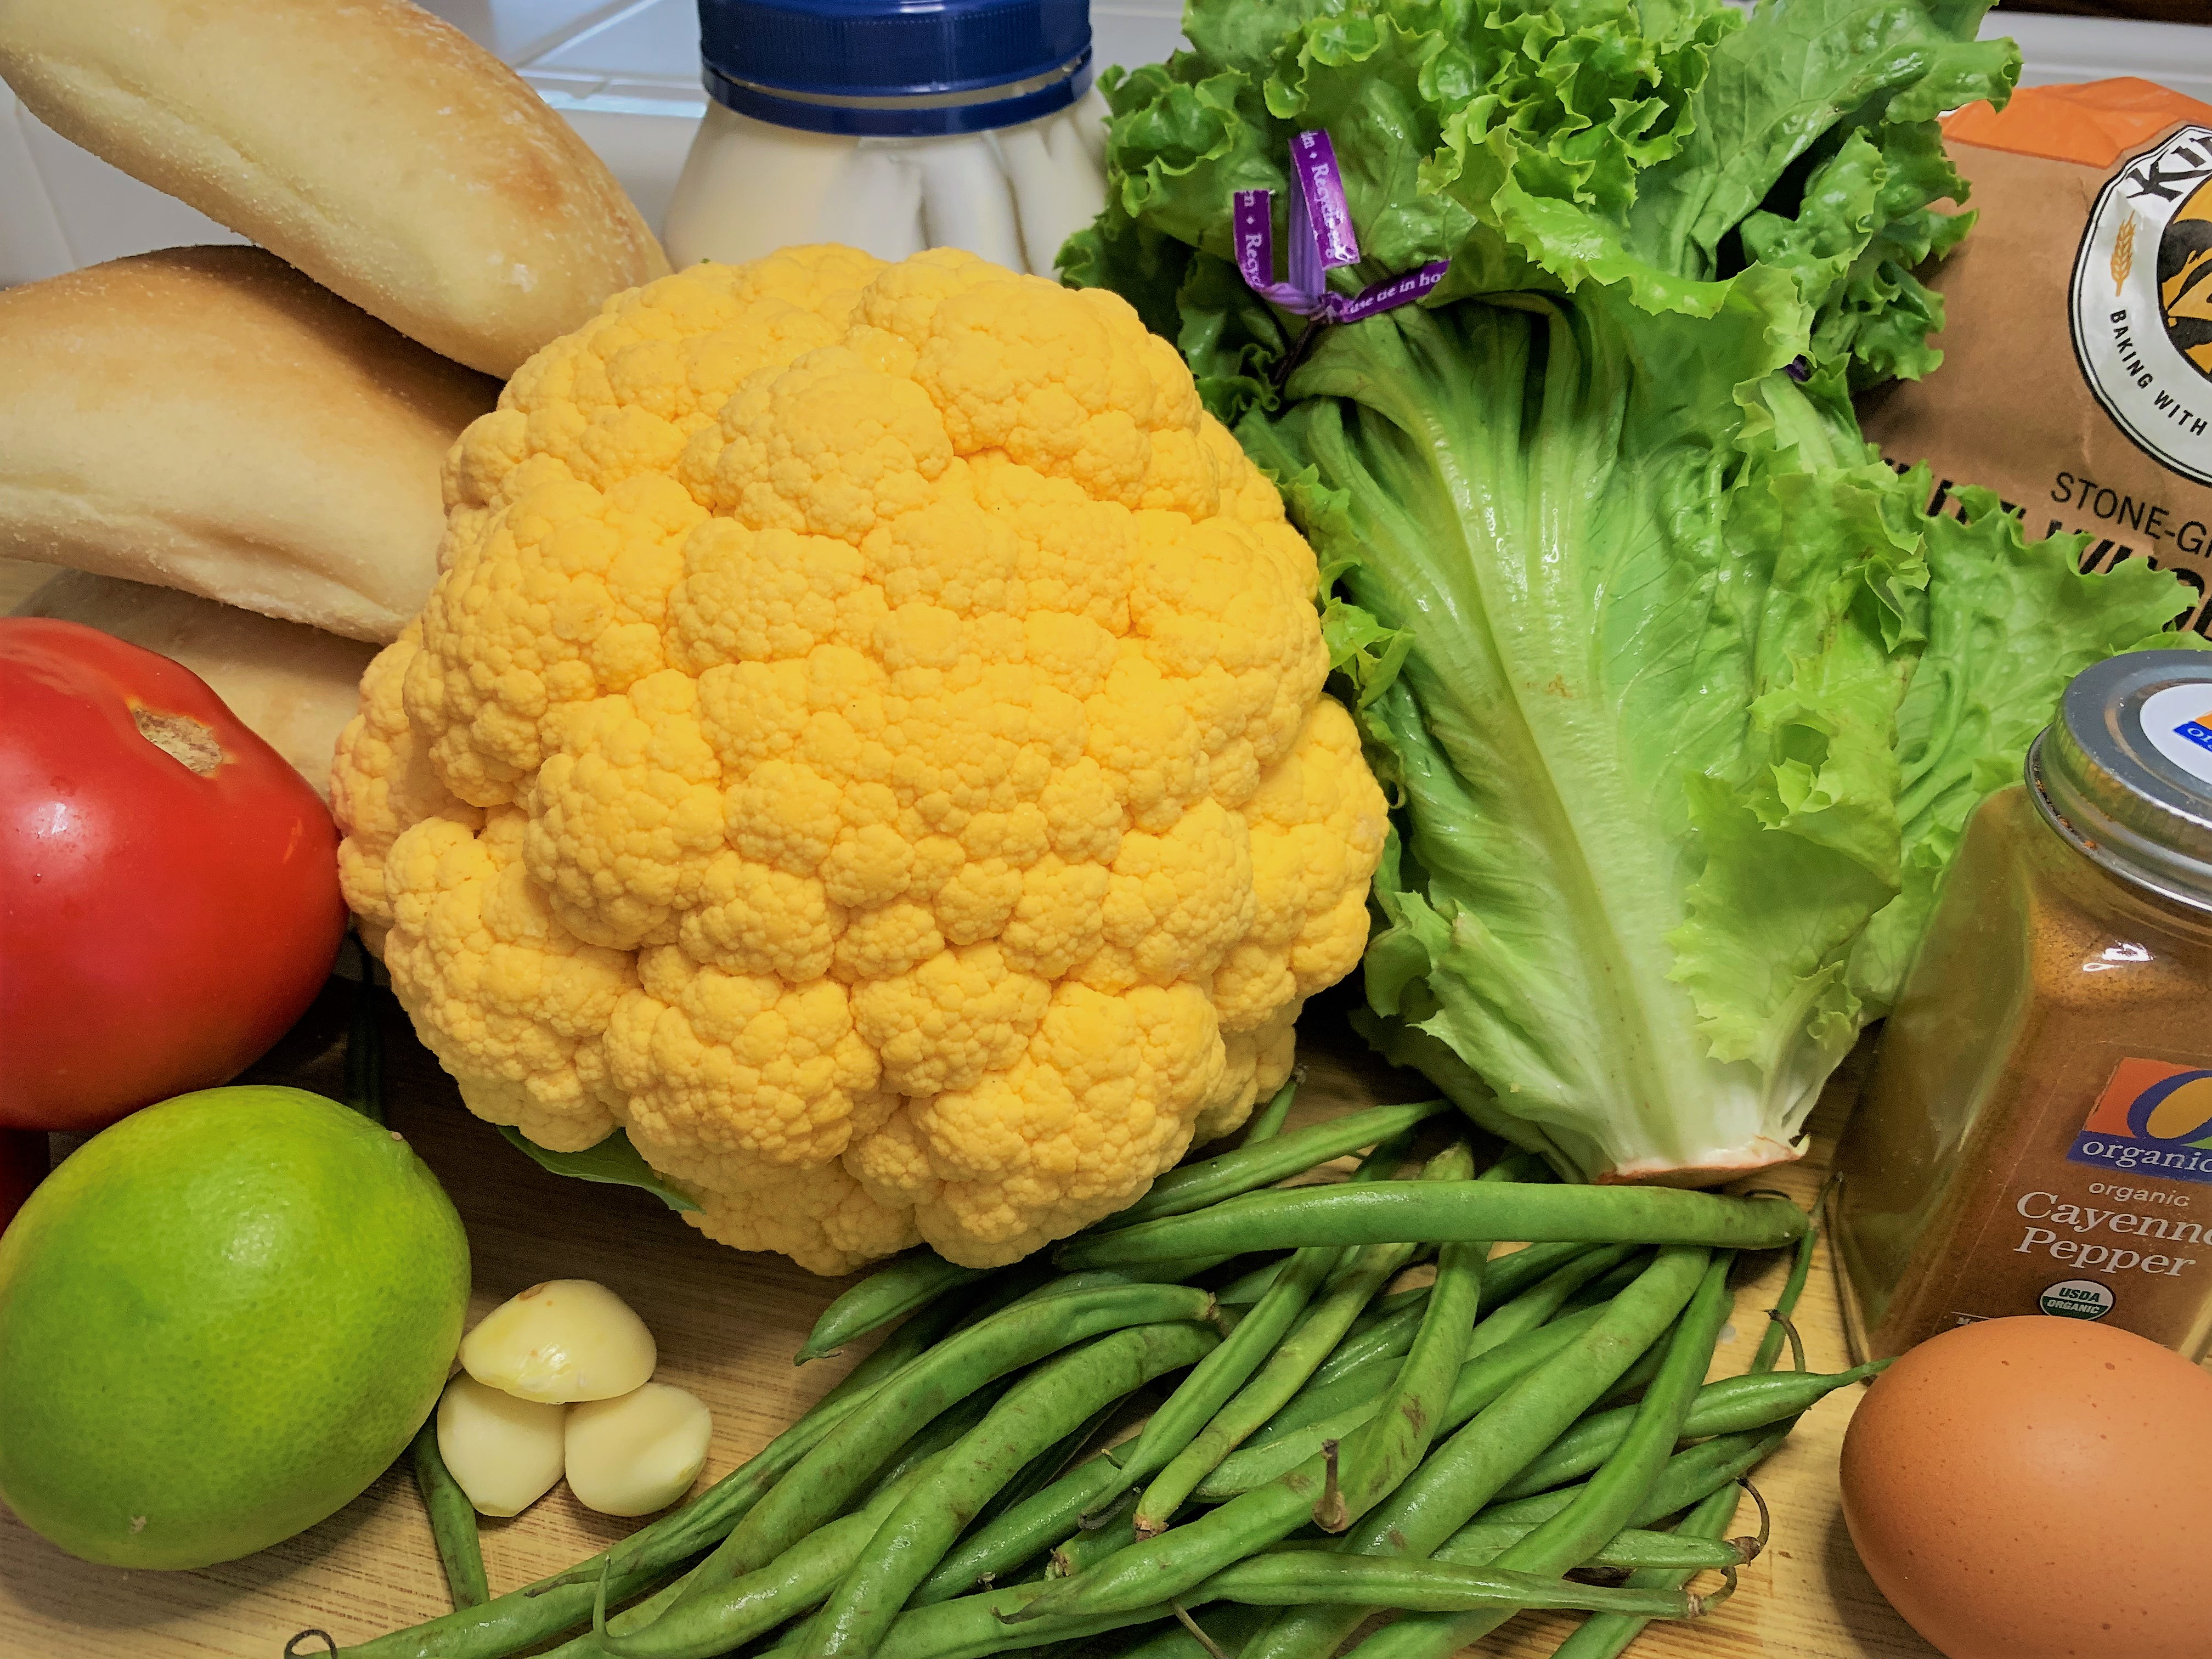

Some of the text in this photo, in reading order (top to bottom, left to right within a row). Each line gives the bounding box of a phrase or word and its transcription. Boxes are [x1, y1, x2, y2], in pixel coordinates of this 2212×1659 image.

[1419, 272, 1446, 287] ho
[2110, 309, 2208, 436] BAKING WITH
[2089, 1182, 2191, 1207] organic
[2013, 1226, 2196, 1277] Pepper
[2058, 1287, 2100, 1302] USDA
[2047, 1299, 2100, 1314] ORGANIC
